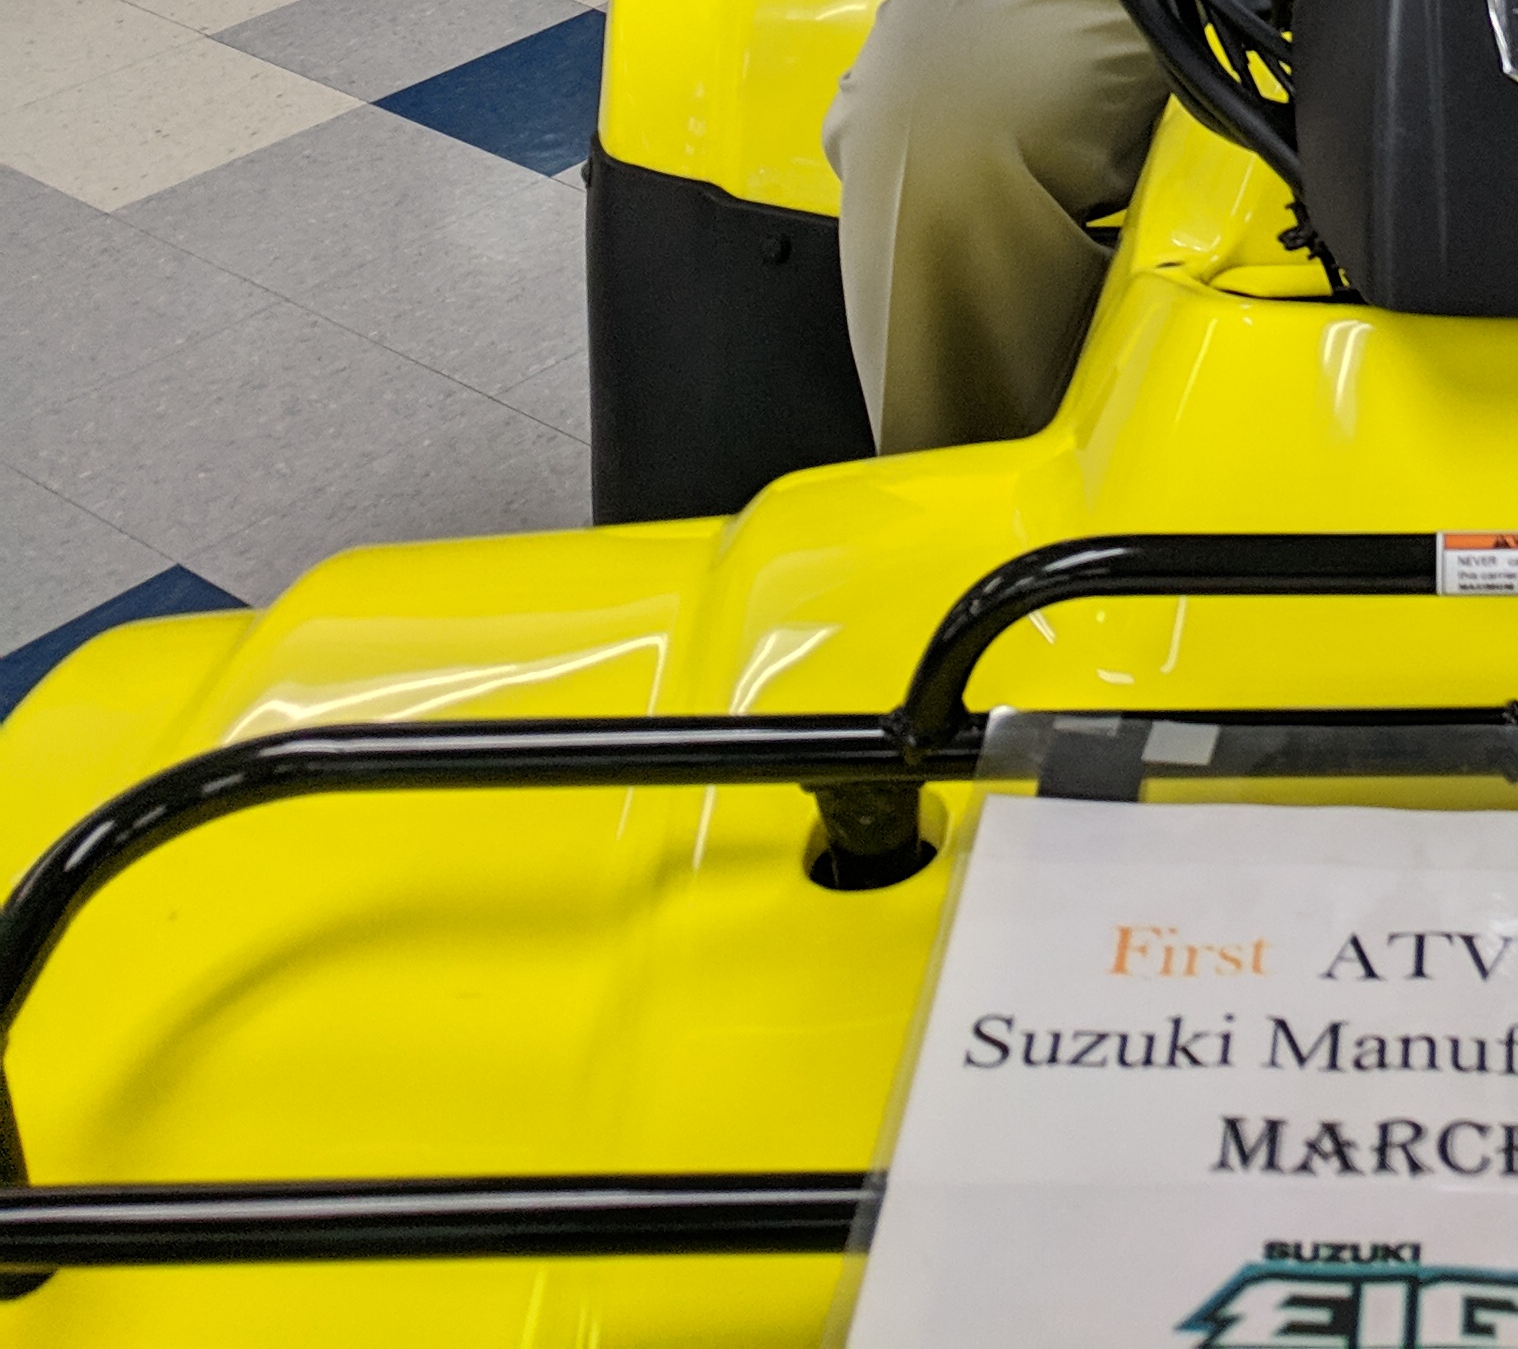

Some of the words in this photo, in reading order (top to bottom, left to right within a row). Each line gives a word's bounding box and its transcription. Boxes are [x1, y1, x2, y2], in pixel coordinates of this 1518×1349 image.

[1457, 555, 1496, 566] NEVER
[1107, 923, 1272, 979] First
[1320, 931, 1518, 983] ATV
[964, 1013, 1238, 1071] Suzuki
[1264, 1241, 1421, 1263] SUZUKI
